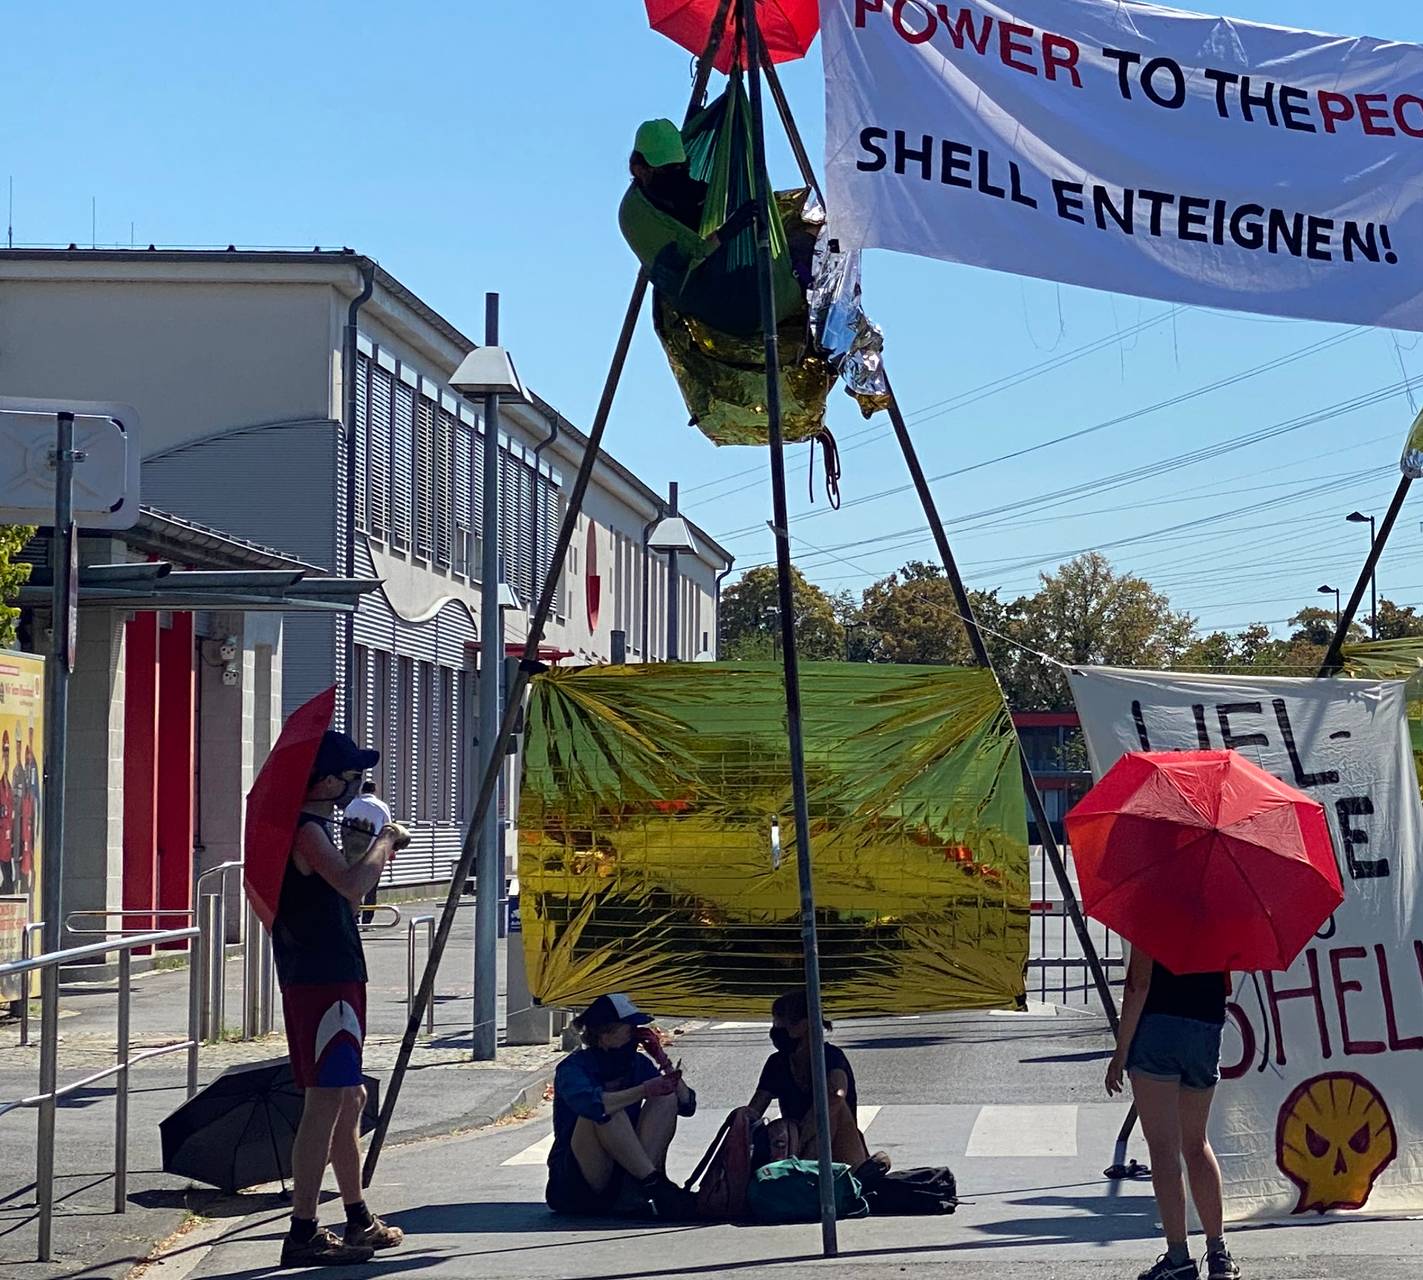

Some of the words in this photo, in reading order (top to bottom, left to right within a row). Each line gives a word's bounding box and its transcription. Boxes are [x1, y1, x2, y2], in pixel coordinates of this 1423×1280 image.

[855, 0, 1083, 88] POWER
[1102, 48, 1187, 109] TO
[857, 126, 1038, 209] SHELL
[1051, 179, 1398, 265] ENTEIGNEN!
